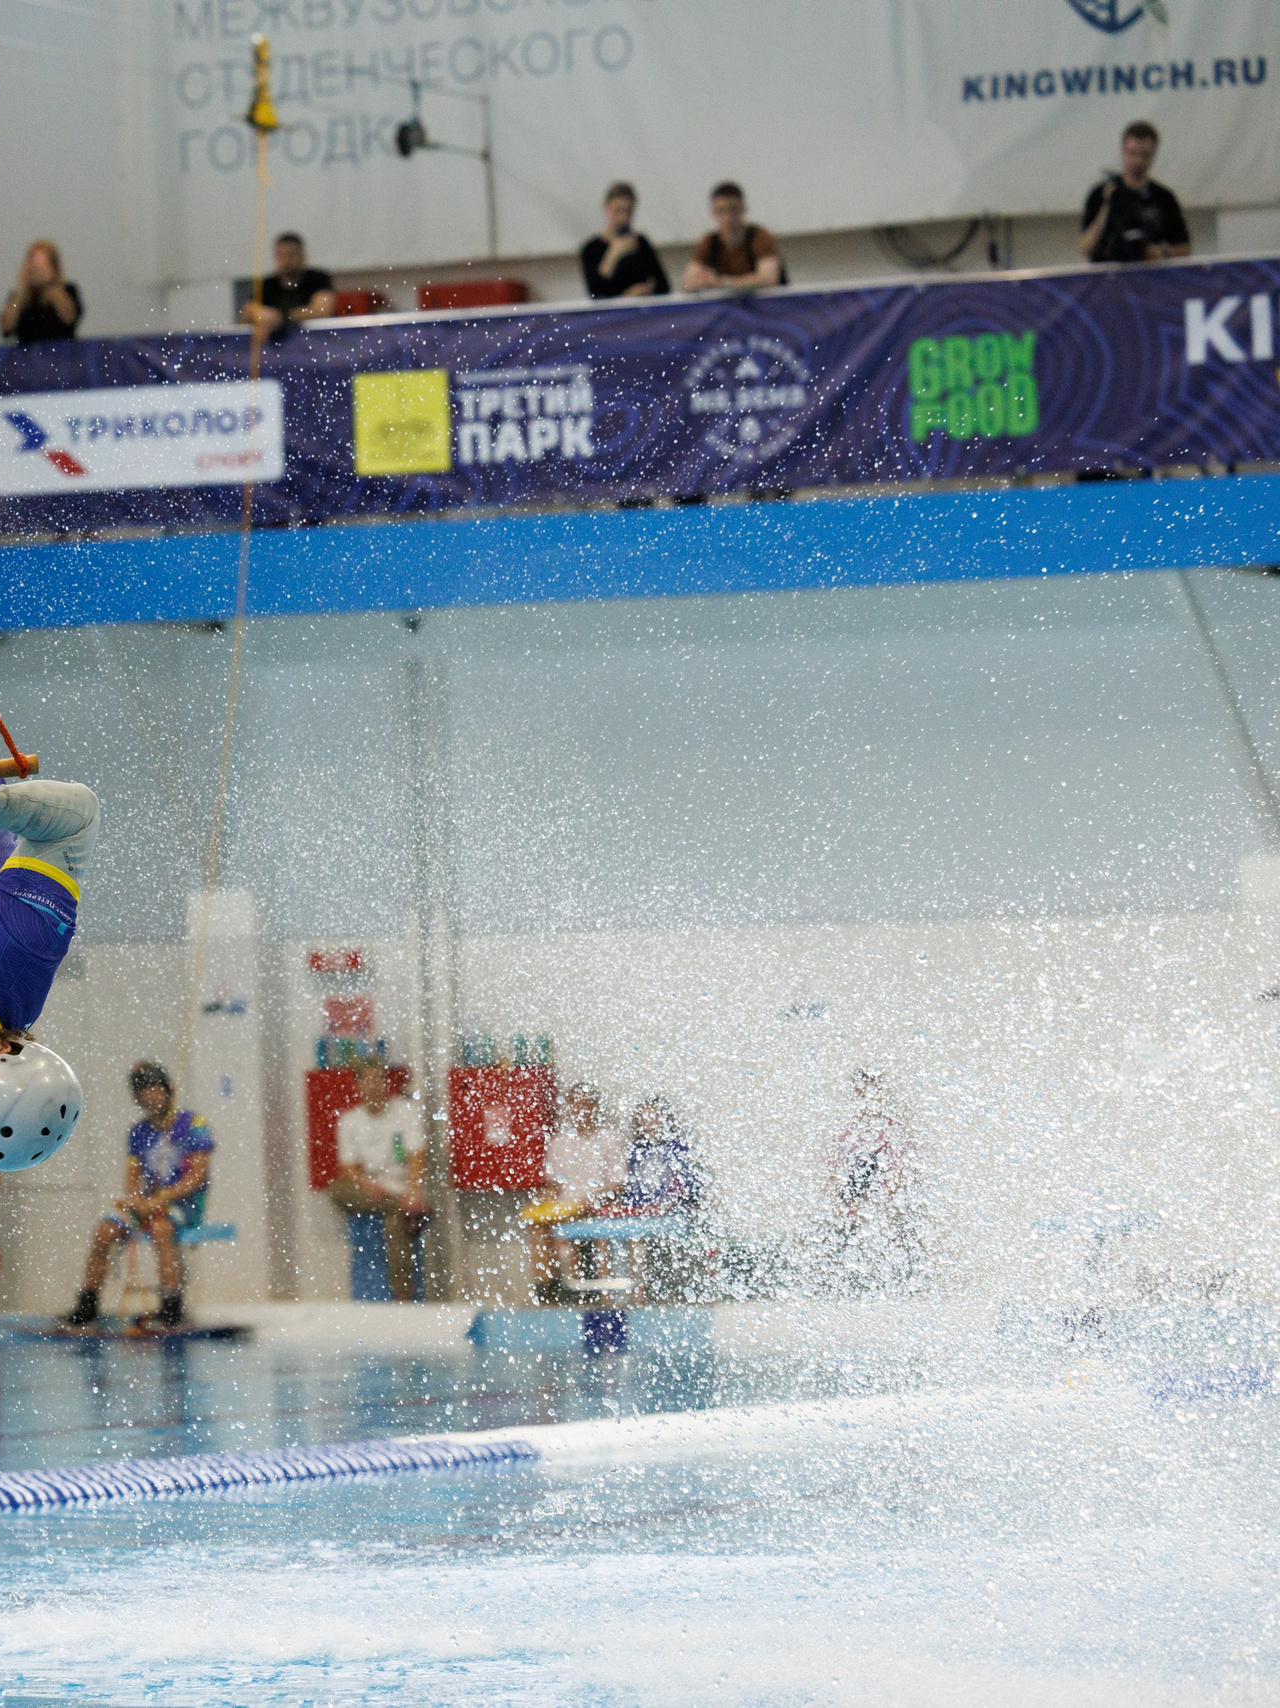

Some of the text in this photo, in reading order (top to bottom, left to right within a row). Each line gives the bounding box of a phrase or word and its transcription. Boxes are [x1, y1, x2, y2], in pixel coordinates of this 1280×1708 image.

[175, 24, 632, 110] СТДЕНЧЕСКОГО
[962, 56, 1267, 103] KINGWINCH.RU
[65, 405, 263, 445] ТРИКОЛОР
[909, 373, 1039, 443] FOOD
[458, 416, 594, 465] ПАРК
